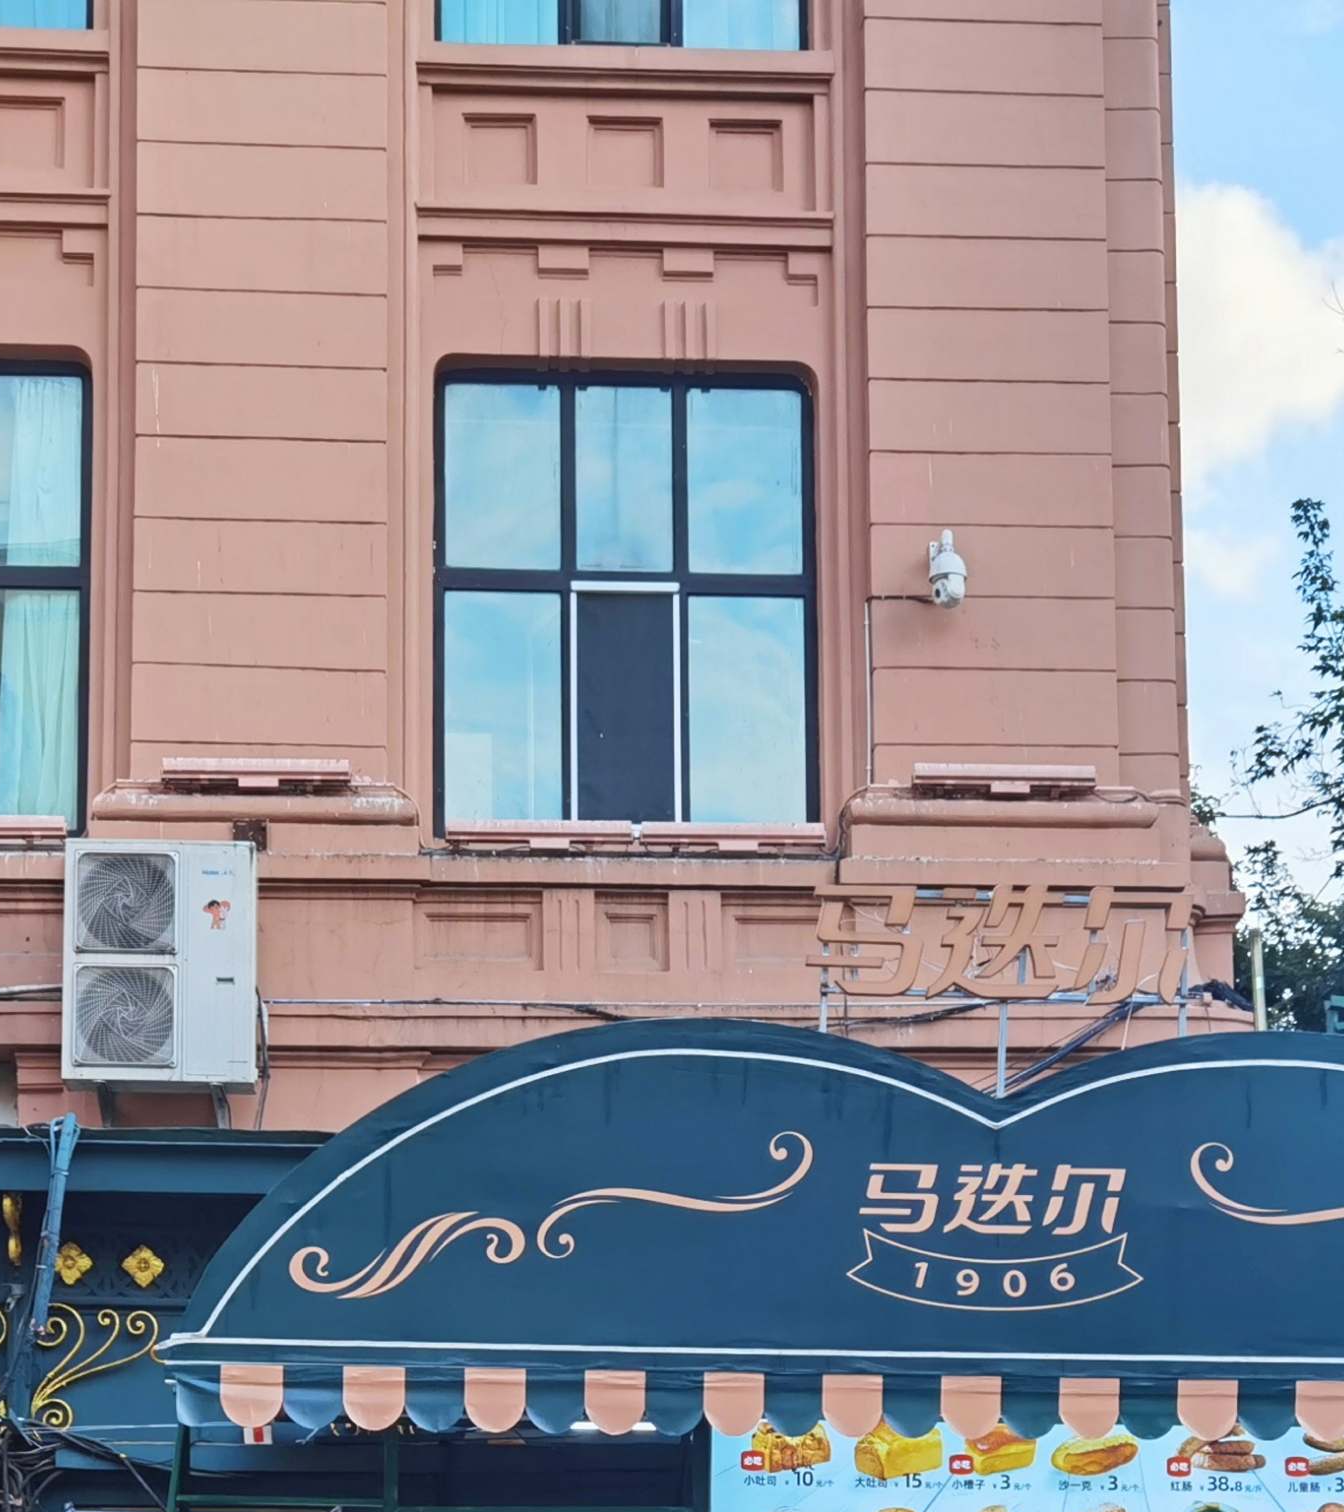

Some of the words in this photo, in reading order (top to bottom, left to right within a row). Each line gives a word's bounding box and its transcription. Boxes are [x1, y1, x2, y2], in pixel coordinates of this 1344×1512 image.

[805, 884, 1194, 1005] 马迭尔
[859, 1162, 1126, 1235] 马迭尔
[914, 1262, 1076, 1297] 1906
[743, 1475, 777, 1487] 小吐司
[855, 1476, 888, 1489] 大吐司
[1170, 1481, 1193, 1491] 红肠
[1288, 1482, 1321, 1493] 儿童肠
